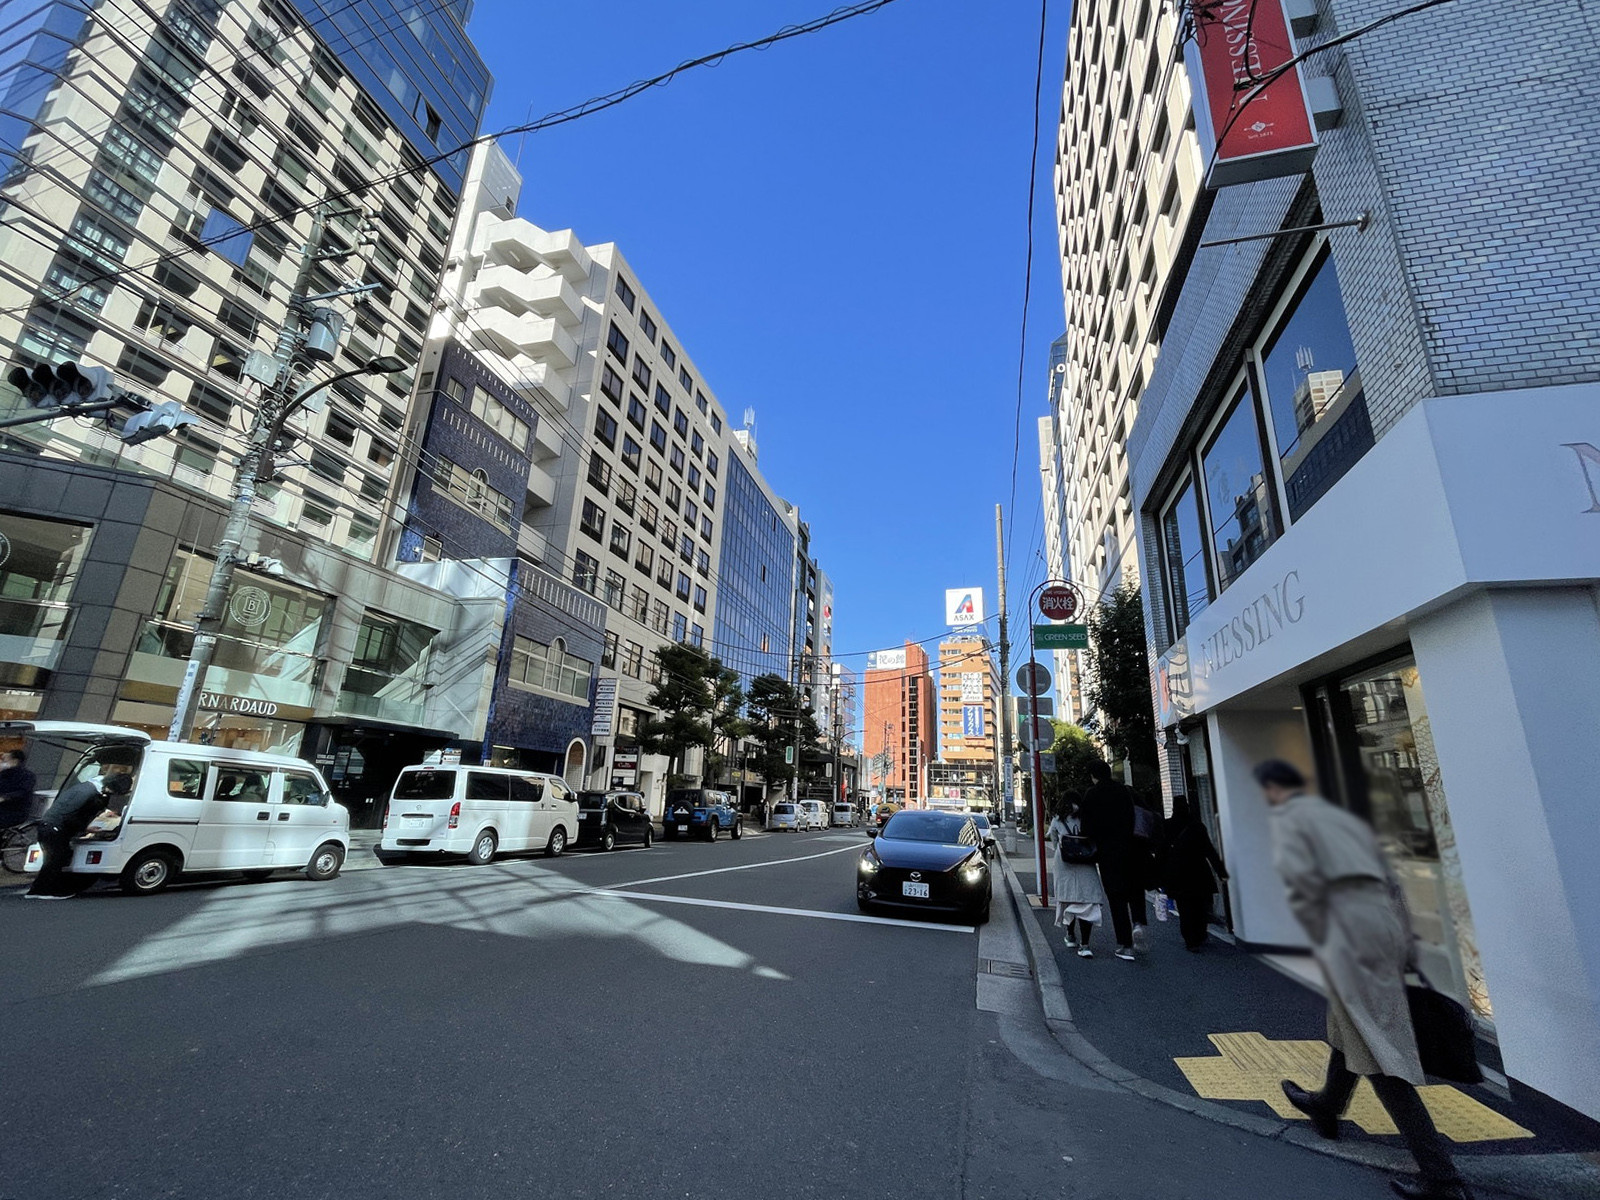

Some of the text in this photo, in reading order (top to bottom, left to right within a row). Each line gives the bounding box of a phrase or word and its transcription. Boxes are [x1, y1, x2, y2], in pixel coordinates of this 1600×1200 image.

[1219, 0, 1269, 106] NIESSIN
[1042, 597, 1075, 610] 消火栓
[1199, 570, 1306, 679] NIESSING
[1044, 633, 1068, 641] GREEN
[1068, 633, 1087, 641] SEED
